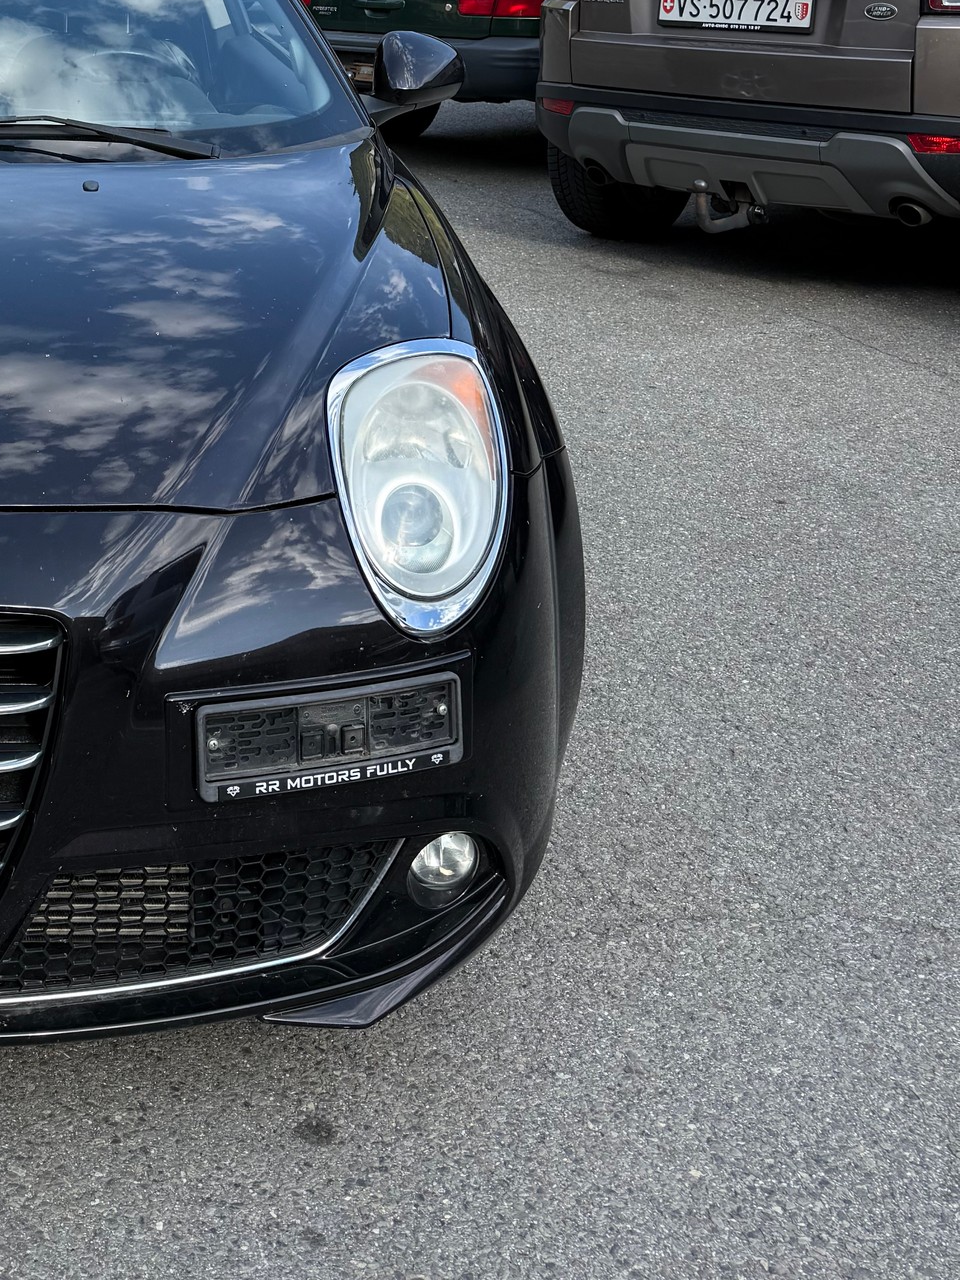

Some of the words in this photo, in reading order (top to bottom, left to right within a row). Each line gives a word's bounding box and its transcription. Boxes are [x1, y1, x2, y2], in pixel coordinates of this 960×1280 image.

[255, 780, 280, 794] RR
[287, 768, 361, 790] MOTORS
[366, 758, 416, 778] FULLY
